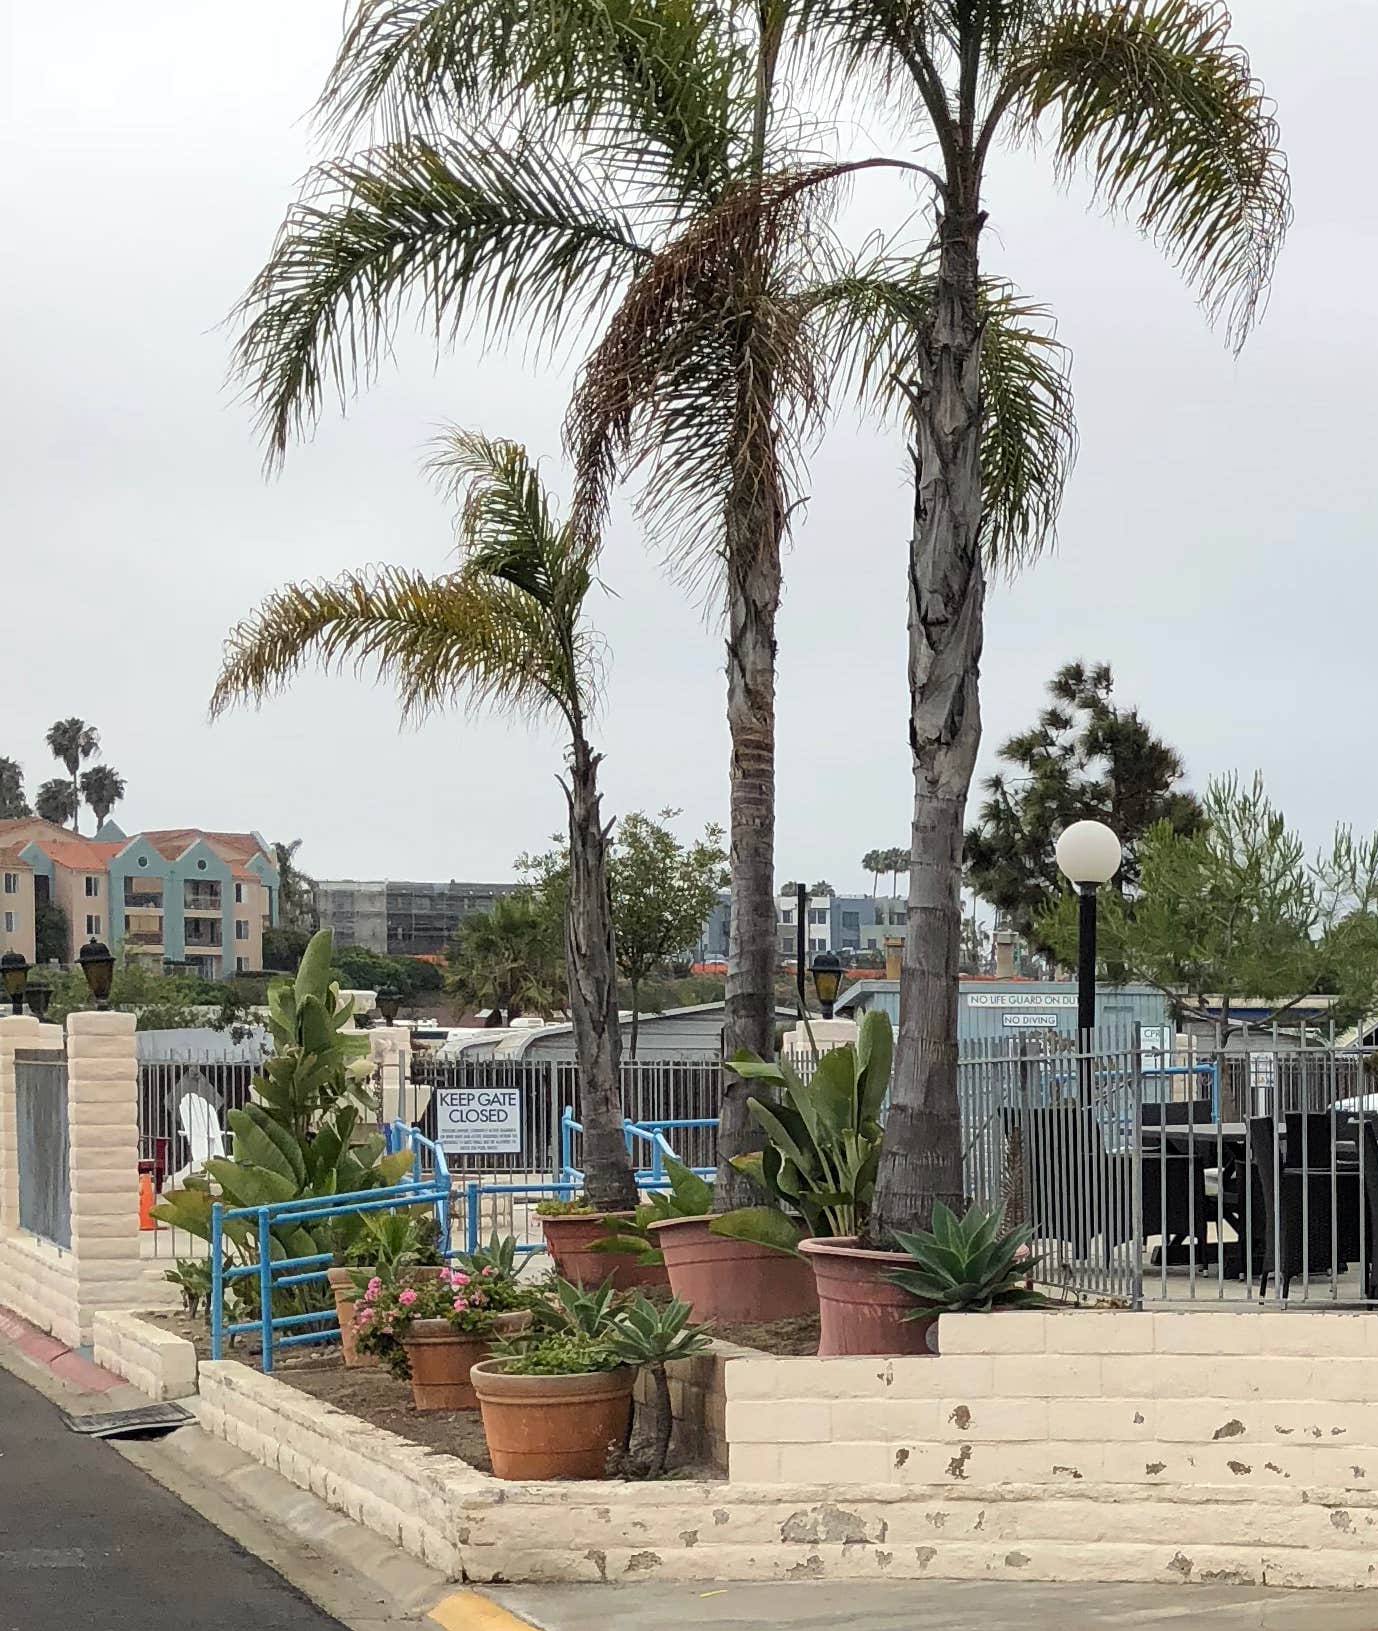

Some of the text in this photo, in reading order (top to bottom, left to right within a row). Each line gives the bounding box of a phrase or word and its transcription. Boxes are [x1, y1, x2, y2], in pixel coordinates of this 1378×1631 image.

[970, 995, 1079, 1005] NO LIFE GUARD ON DU
[1004, 1016, 1056, 1025] NO DIVING
[440, 1092, 517, 1107] KEEP GATE
[448, 1108, 509, 1123] CLOSED
